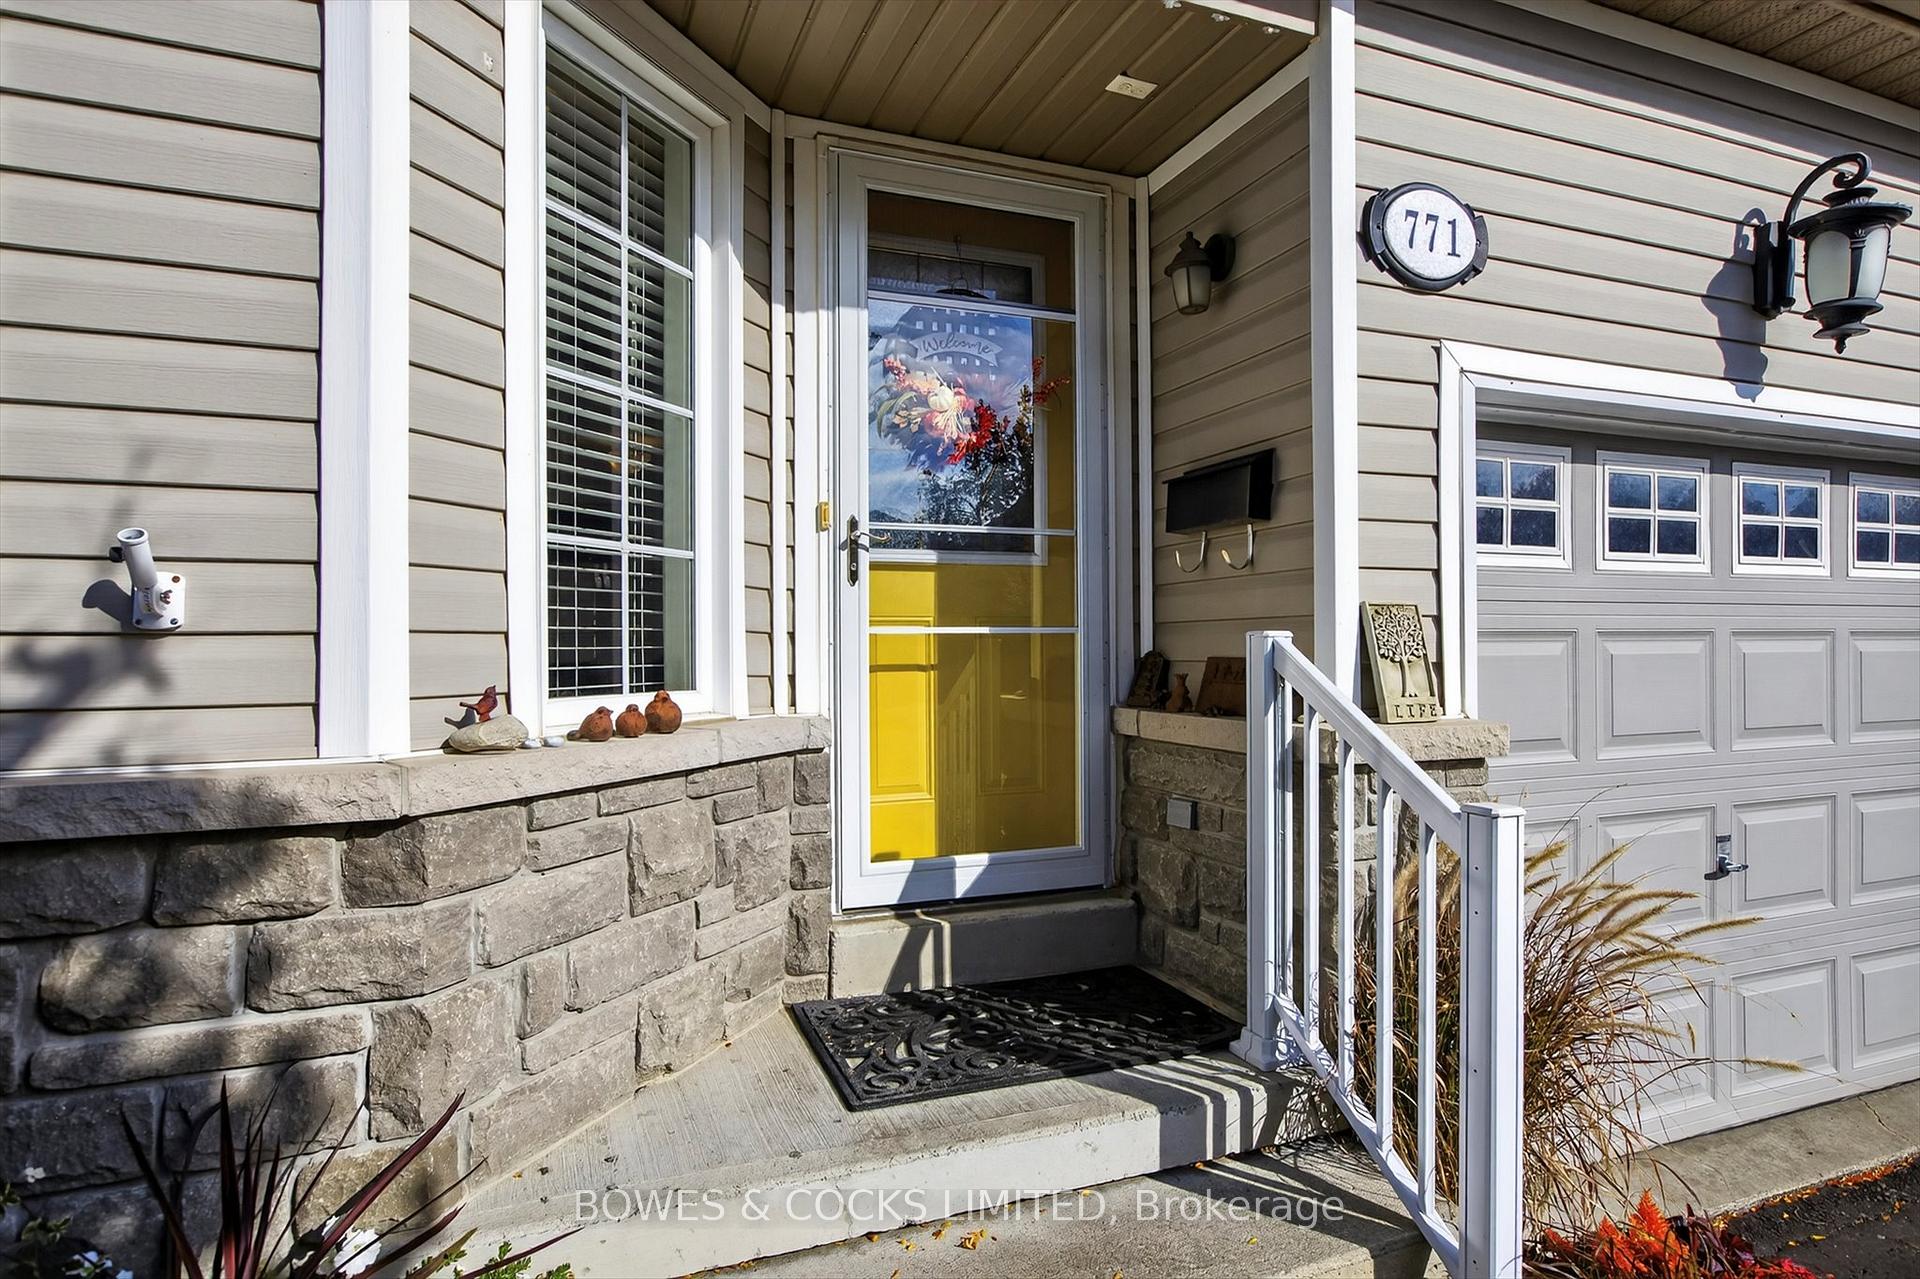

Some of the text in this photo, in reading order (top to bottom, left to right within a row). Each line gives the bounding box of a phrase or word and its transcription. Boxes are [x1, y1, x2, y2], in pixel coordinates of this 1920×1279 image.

[1404, 209, 1461, 258] 771
[922, 332, 991, 354] Welcome
[1394, 703, 1438, 718] LIFE
